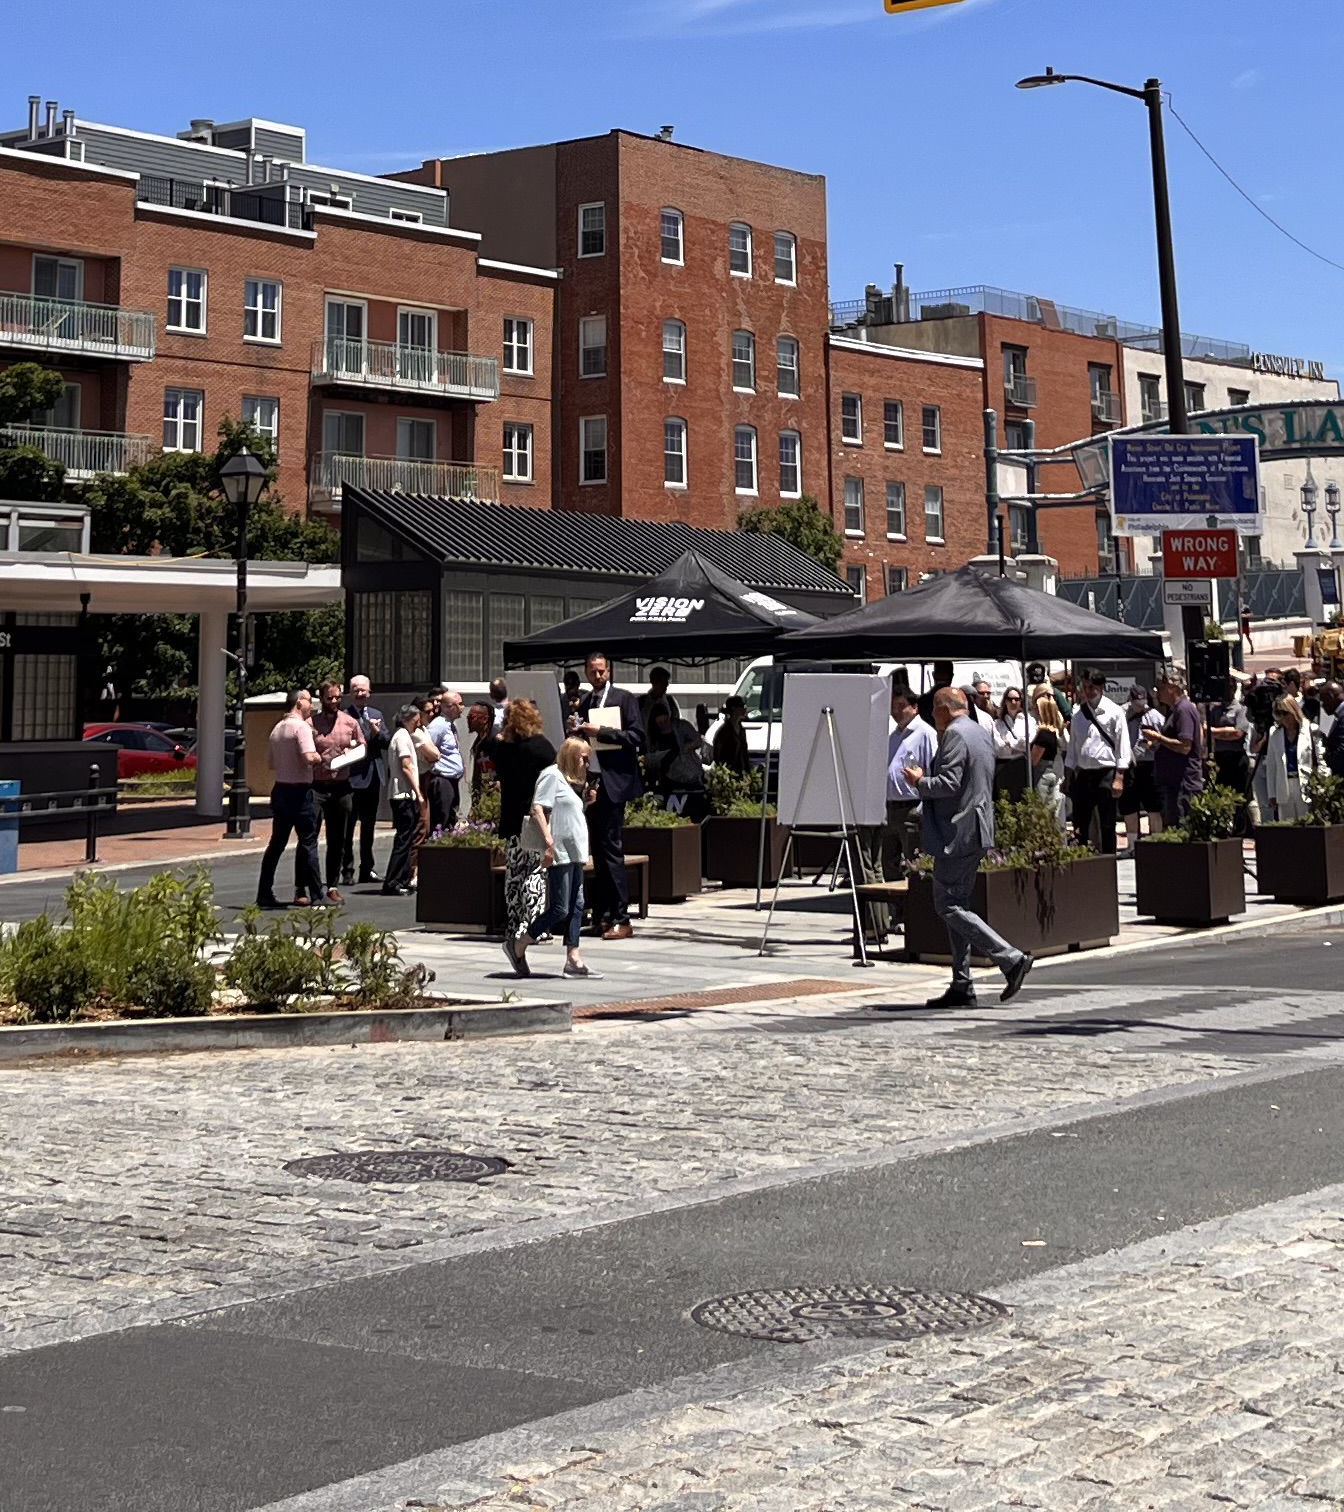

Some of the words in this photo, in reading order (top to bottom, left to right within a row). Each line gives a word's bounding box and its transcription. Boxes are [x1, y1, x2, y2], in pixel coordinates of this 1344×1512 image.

[1170, 537, 1229, 552] WRONG
[1182, 556, 1217, 571] WAY
[1182, 583, 1193, 592] NO
[635, 596, 705, 611] VISION
[635, 606, 690, 617] ZERO
